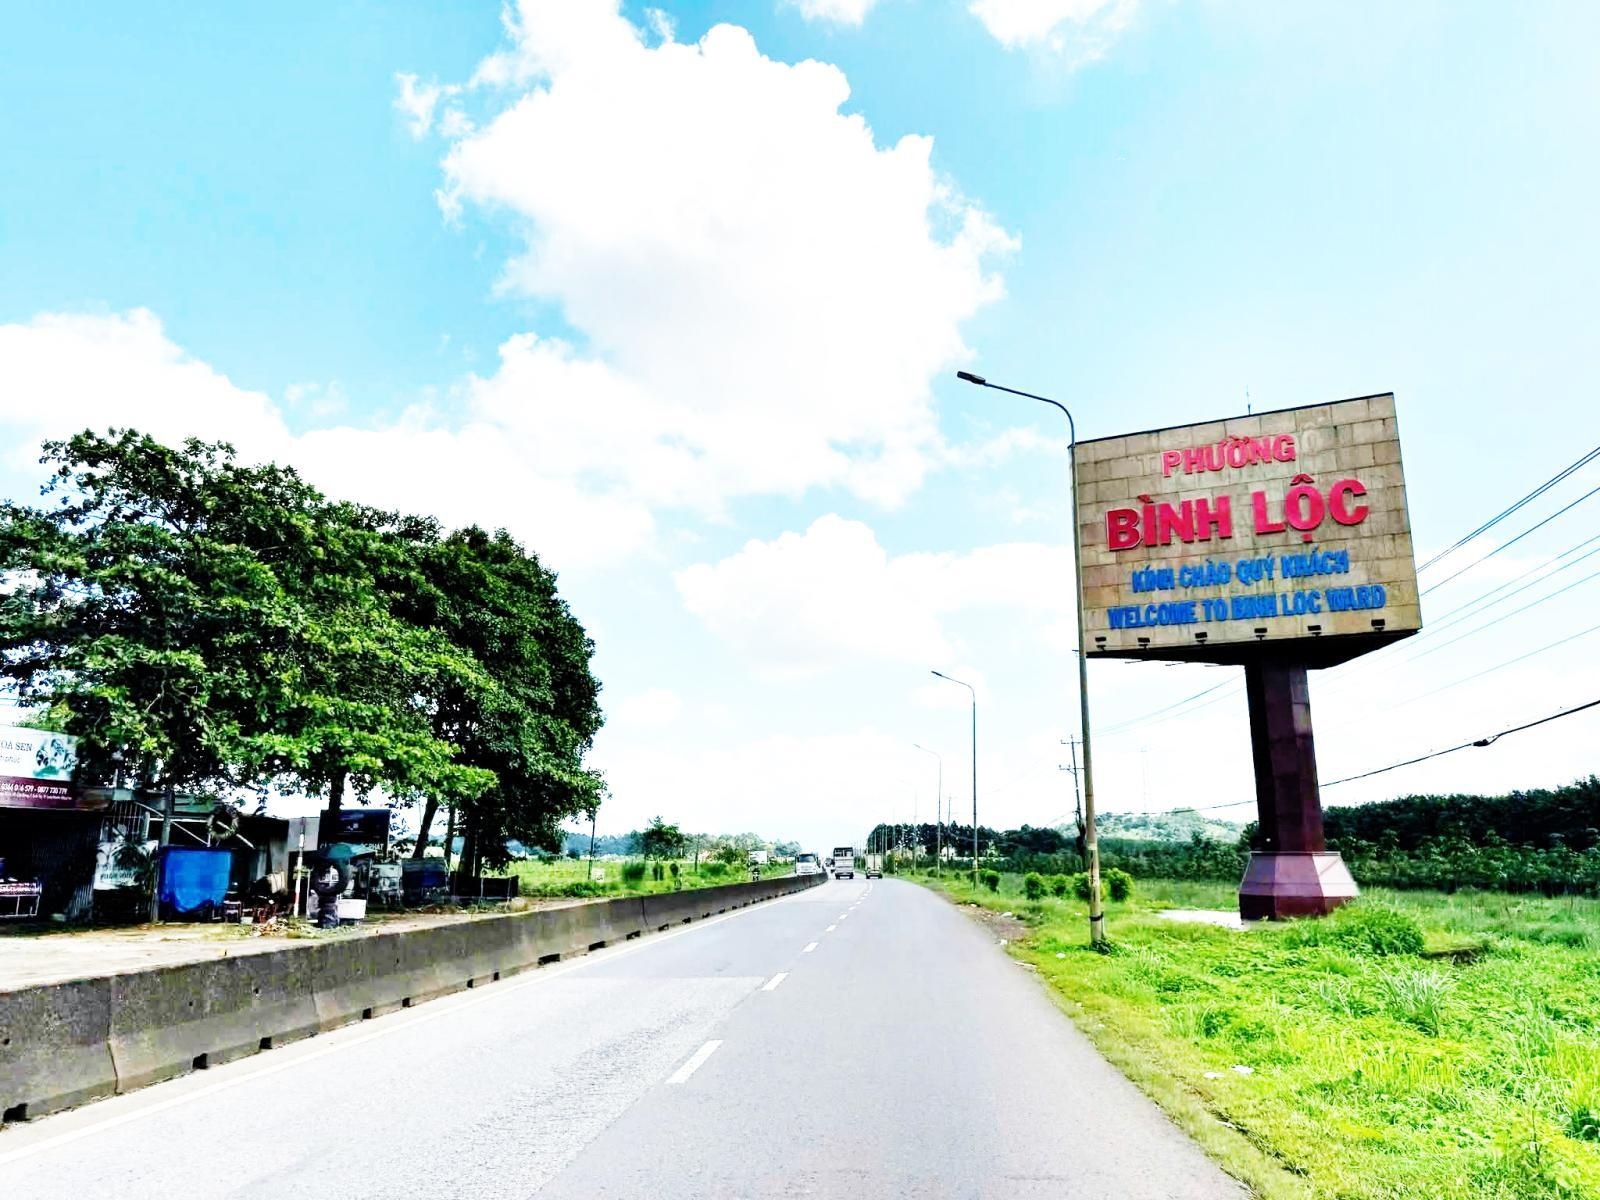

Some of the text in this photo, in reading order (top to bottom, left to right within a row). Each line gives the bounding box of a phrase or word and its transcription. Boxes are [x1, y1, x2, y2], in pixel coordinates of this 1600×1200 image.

[1161, 433, 1296, 477] PHƯỜNG
[1105, 473, 1370, 551] BÌNH LỘC
[1132, 546, 1350, 593] KÍNH CHÀO QUÝ KHÁCH
[1107, 584, 1387, 629] WELCOME TO BINH LOC WARD
